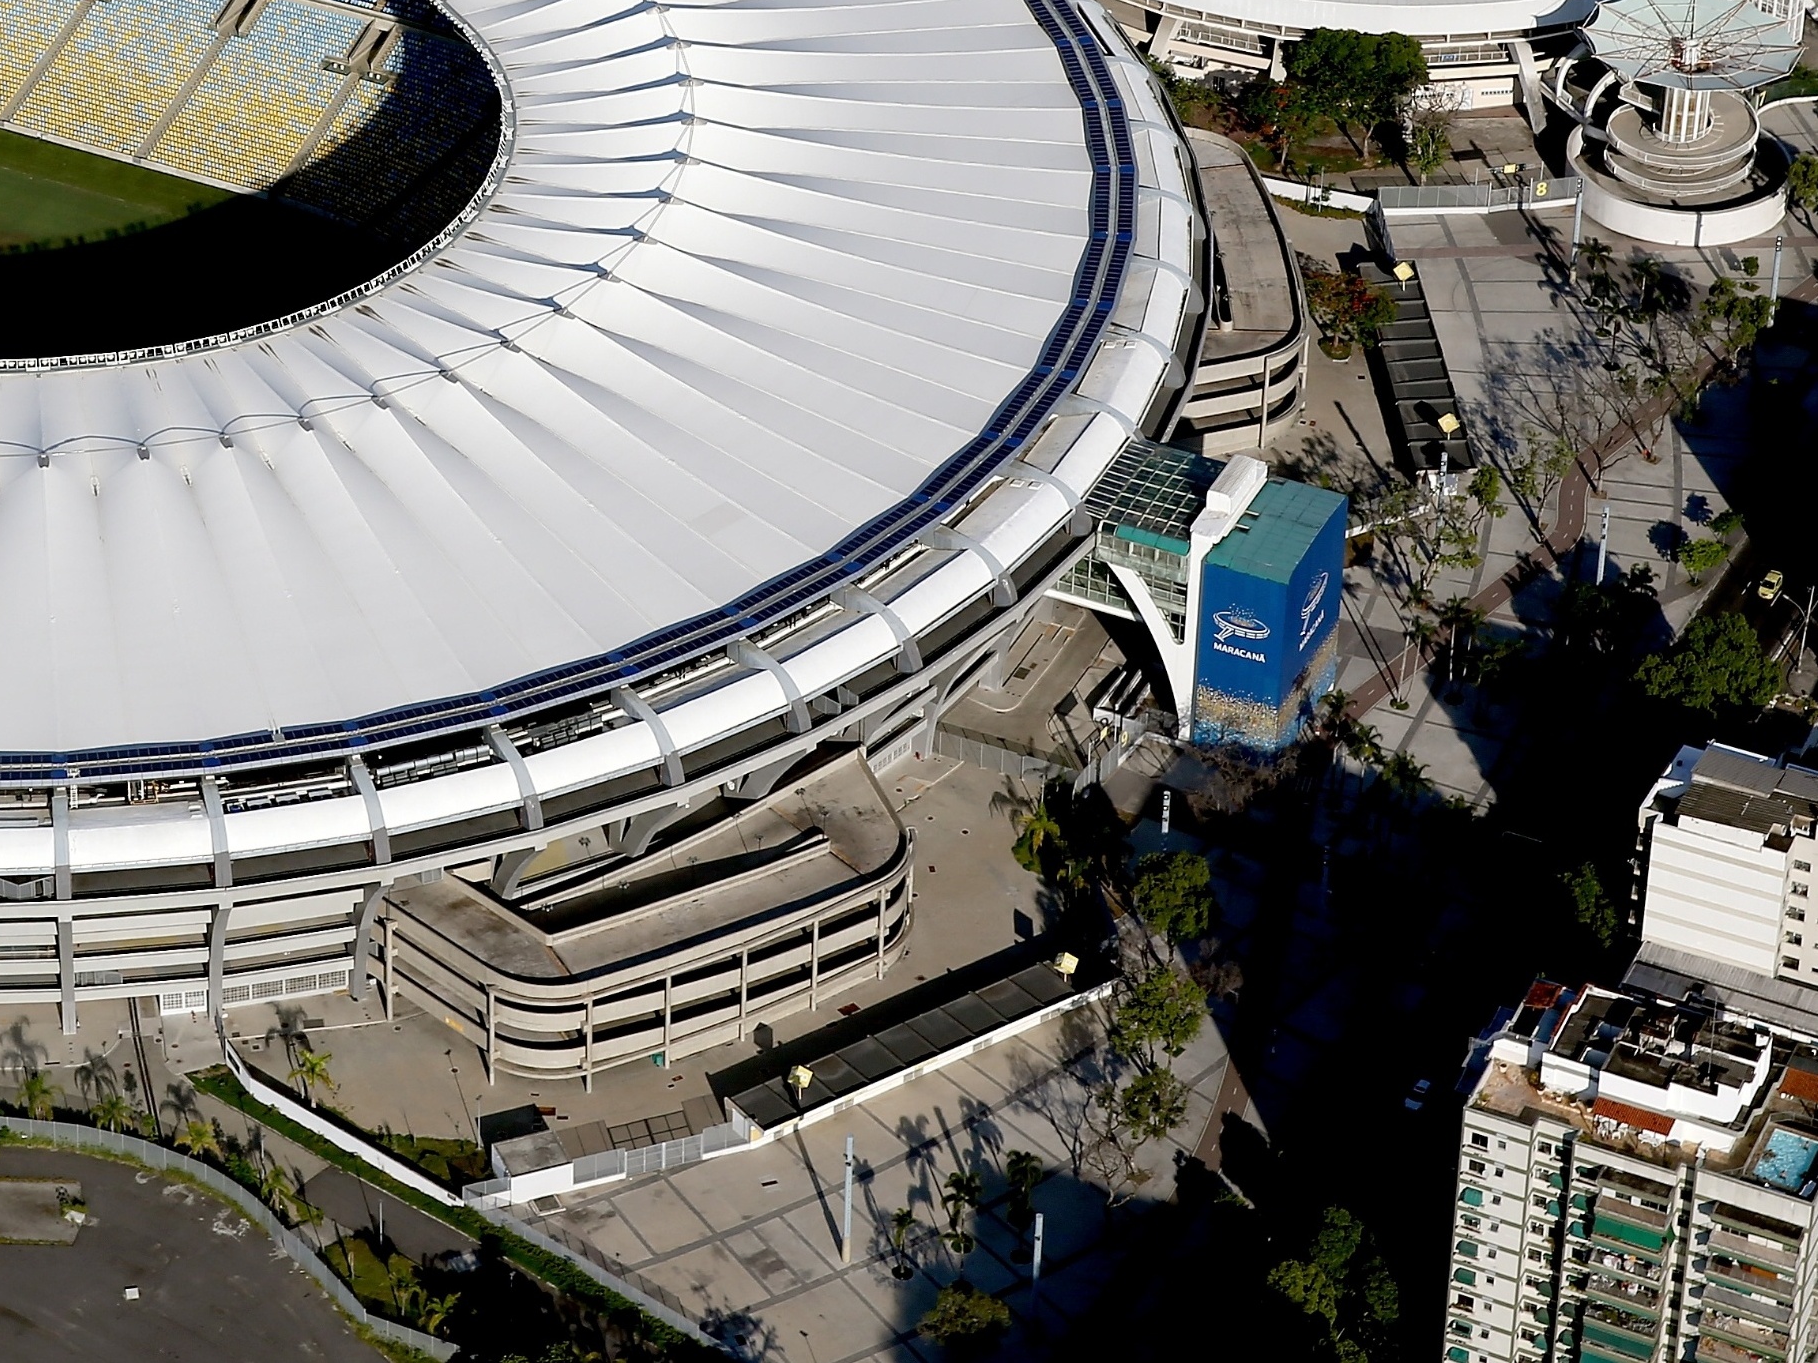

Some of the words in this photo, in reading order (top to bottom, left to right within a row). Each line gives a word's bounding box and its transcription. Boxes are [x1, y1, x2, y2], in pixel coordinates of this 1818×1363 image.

[1535, 181, 1548, 197] 8
[1213, 641, 1266, 663] MARACANÃ
[1120, 730, 1130, 748] 9
